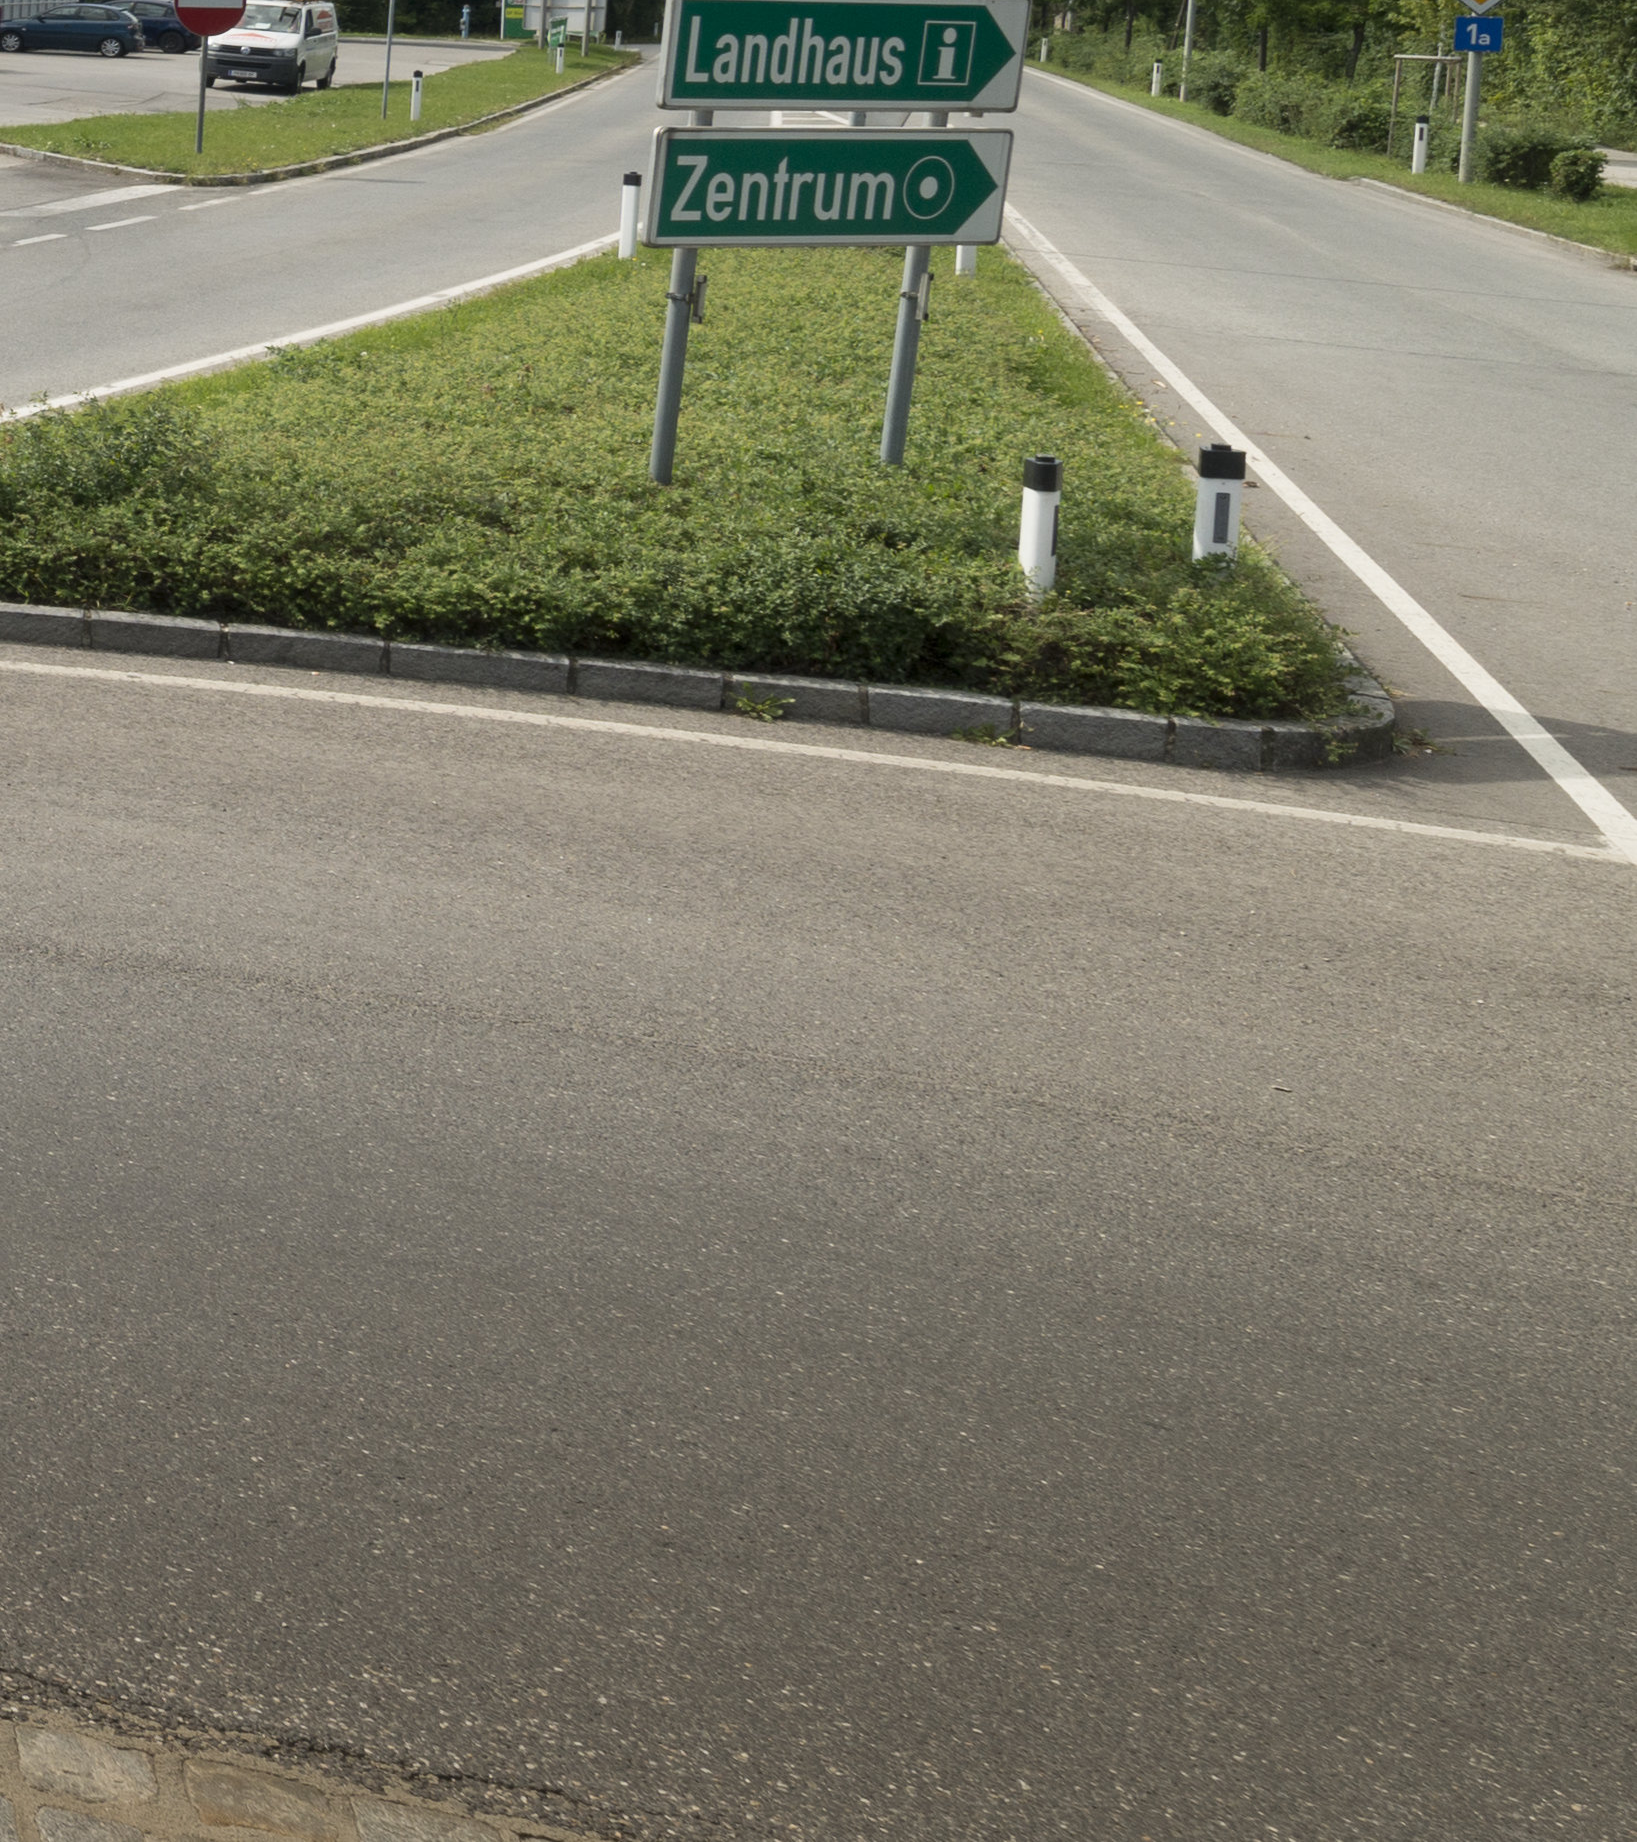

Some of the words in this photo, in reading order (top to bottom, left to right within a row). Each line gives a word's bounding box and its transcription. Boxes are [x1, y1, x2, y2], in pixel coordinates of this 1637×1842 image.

[685, 15, 906, 86] Landhaus
[1467, 23, 1490, 45] 1a
[670, 155, 896, 222] Zentrum
